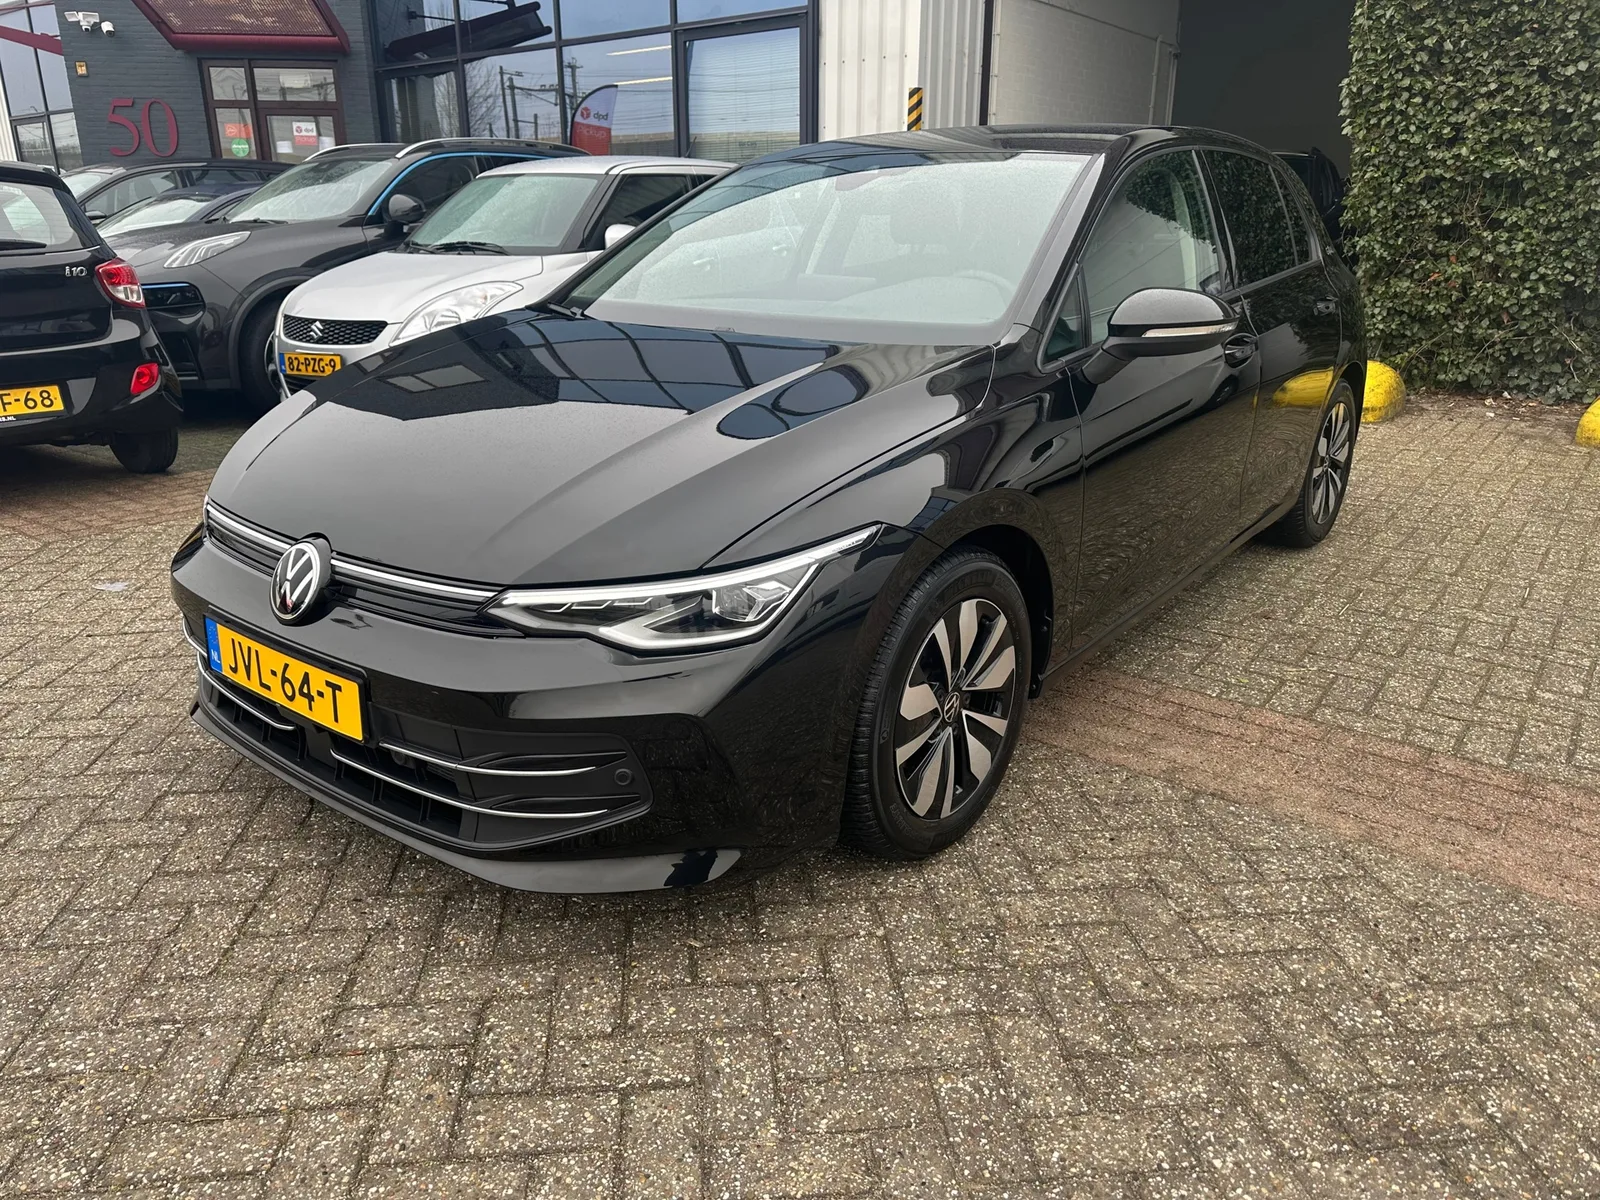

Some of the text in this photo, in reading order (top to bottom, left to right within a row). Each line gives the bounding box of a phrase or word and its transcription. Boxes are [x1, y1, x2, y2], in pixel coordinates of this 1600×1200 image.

[593, 111, 609, 121] dpd
[108, 97, 178, 157] 50
[65, 266, 88, 277] i10
[287, 356, 337, 373] 82-PZG-9
[229, 637, 343, 724] JVL-64-T
